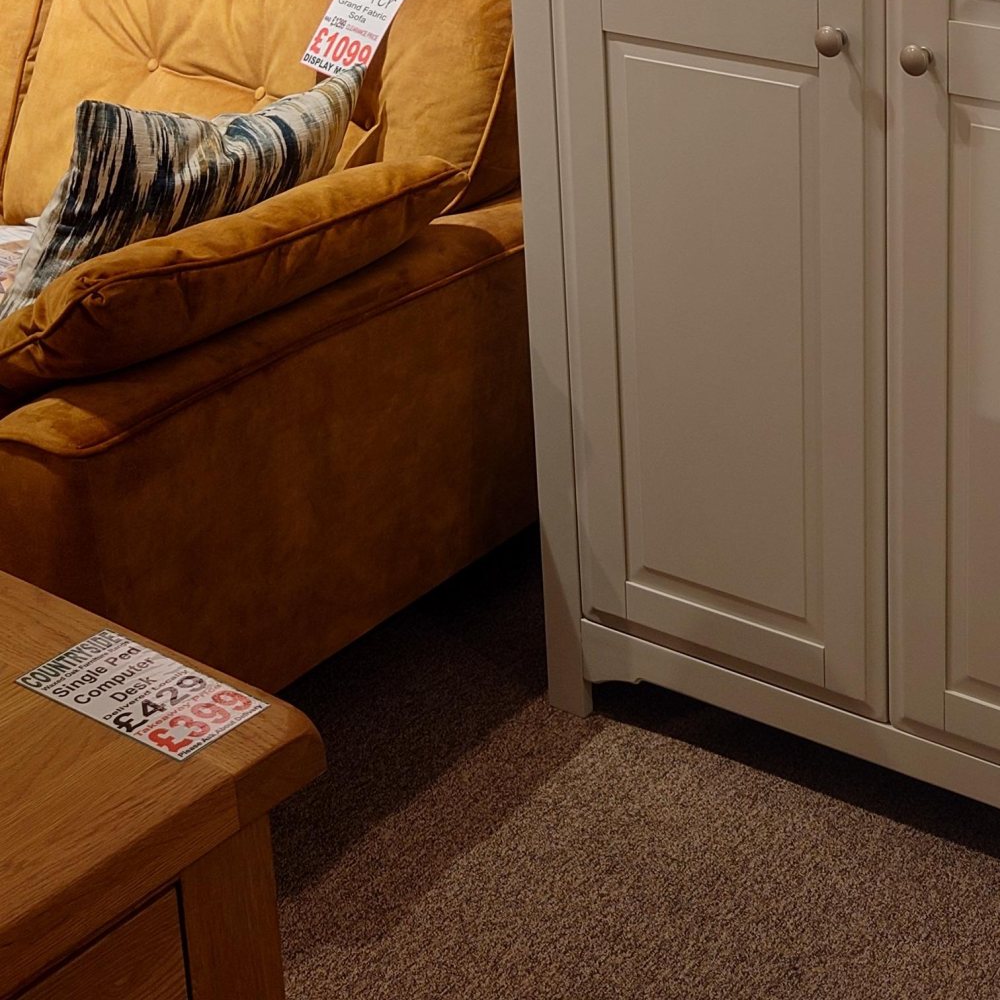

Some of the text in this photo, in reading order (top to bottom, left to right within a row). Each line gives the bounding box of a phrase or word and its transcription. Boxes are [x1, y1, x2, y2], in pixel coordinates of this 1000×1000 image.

[348, 11, 367, 24] Sofa
[362, 6, 387, 21] Fabric
[303, 53, 334, 72] DISPLAY
[310, 27, 372, 67] £1099
[20, 631, 122, 688] COUNTRYSIDE
[52, 646, 142, 697] Single Ped
[64, 668, 81, 677] Oak
[79, 652, 109, 670] Furniture
[73, 657, 156, 704] Computer
[103, 669, 188, 720] Delivered Locally
[109, 676, 158, 702] Desk
[112, 675, 208, 733] £429
[133, 702, 191, 737] Takeaway
[148, 690, 253, 752] £399
[178, 741, 203, 758] Please
